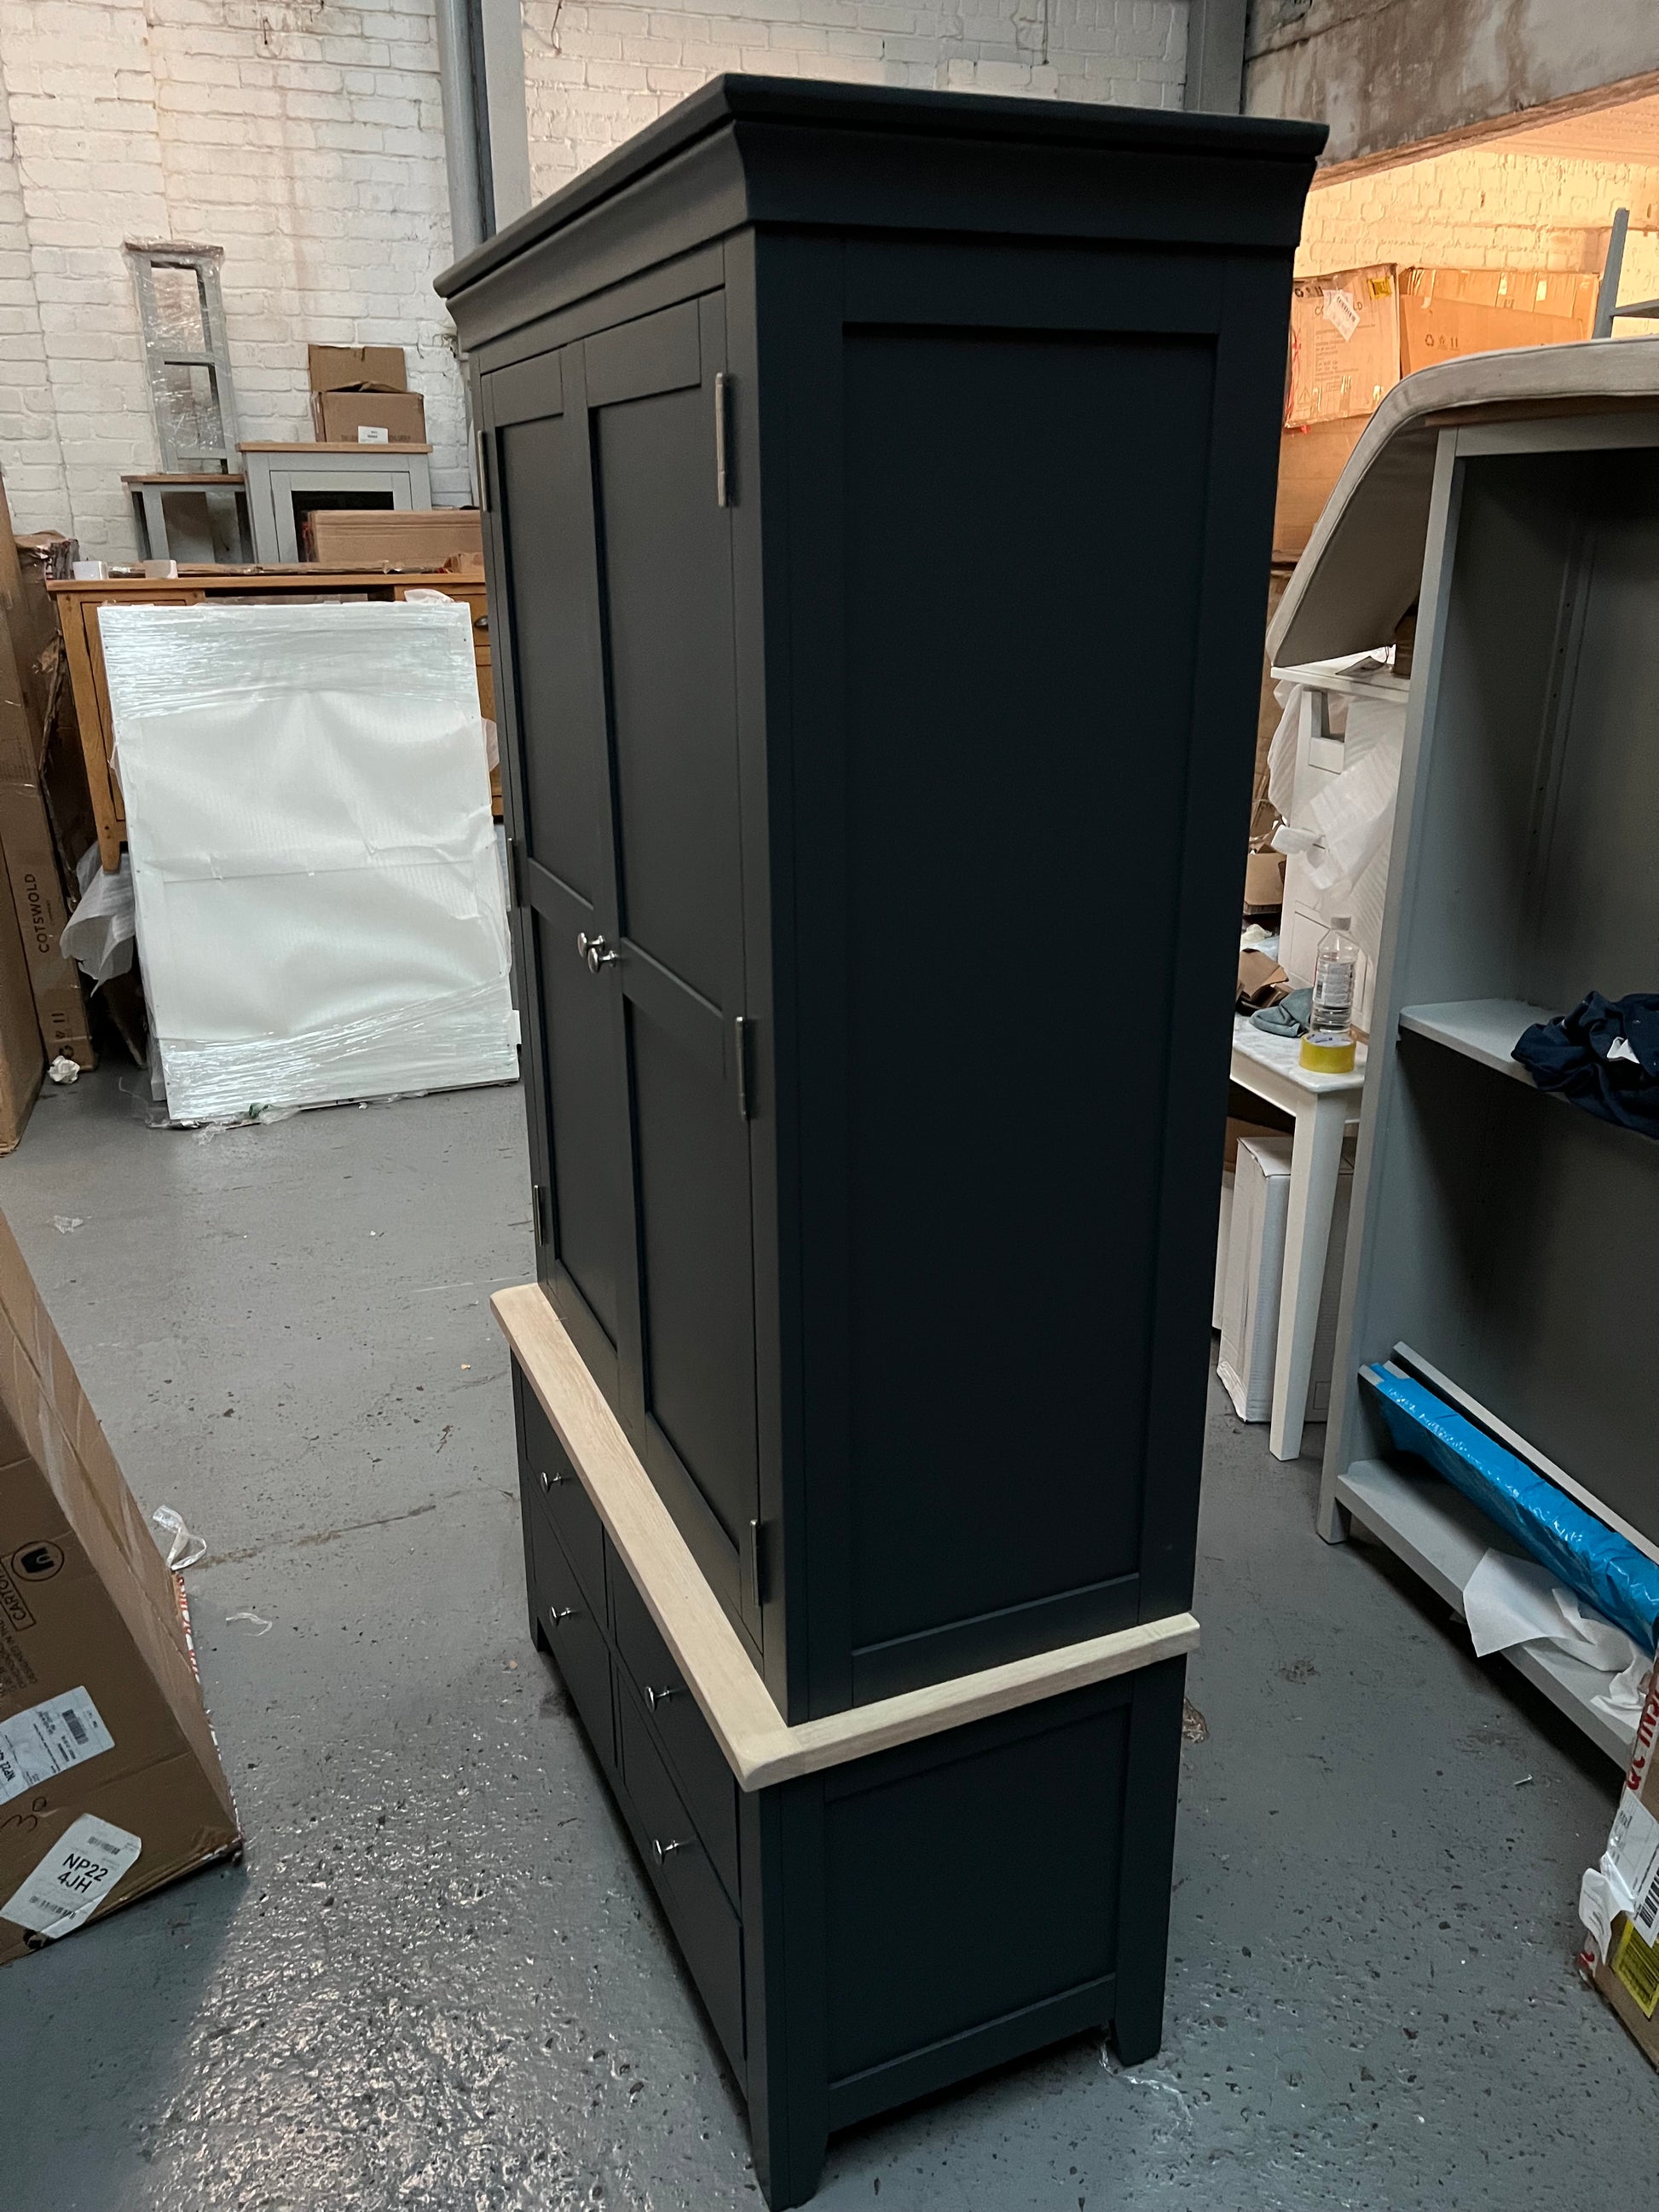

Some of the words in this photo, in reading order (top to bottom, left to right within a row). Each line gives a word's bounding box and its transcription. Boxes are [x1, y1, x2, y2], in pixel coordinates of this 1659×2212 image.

[24, 874, 49, 953] COTSWOLD
[57, 1871, 93, 1893] 4JH
[62, 1853, 108, 1882] NP22
